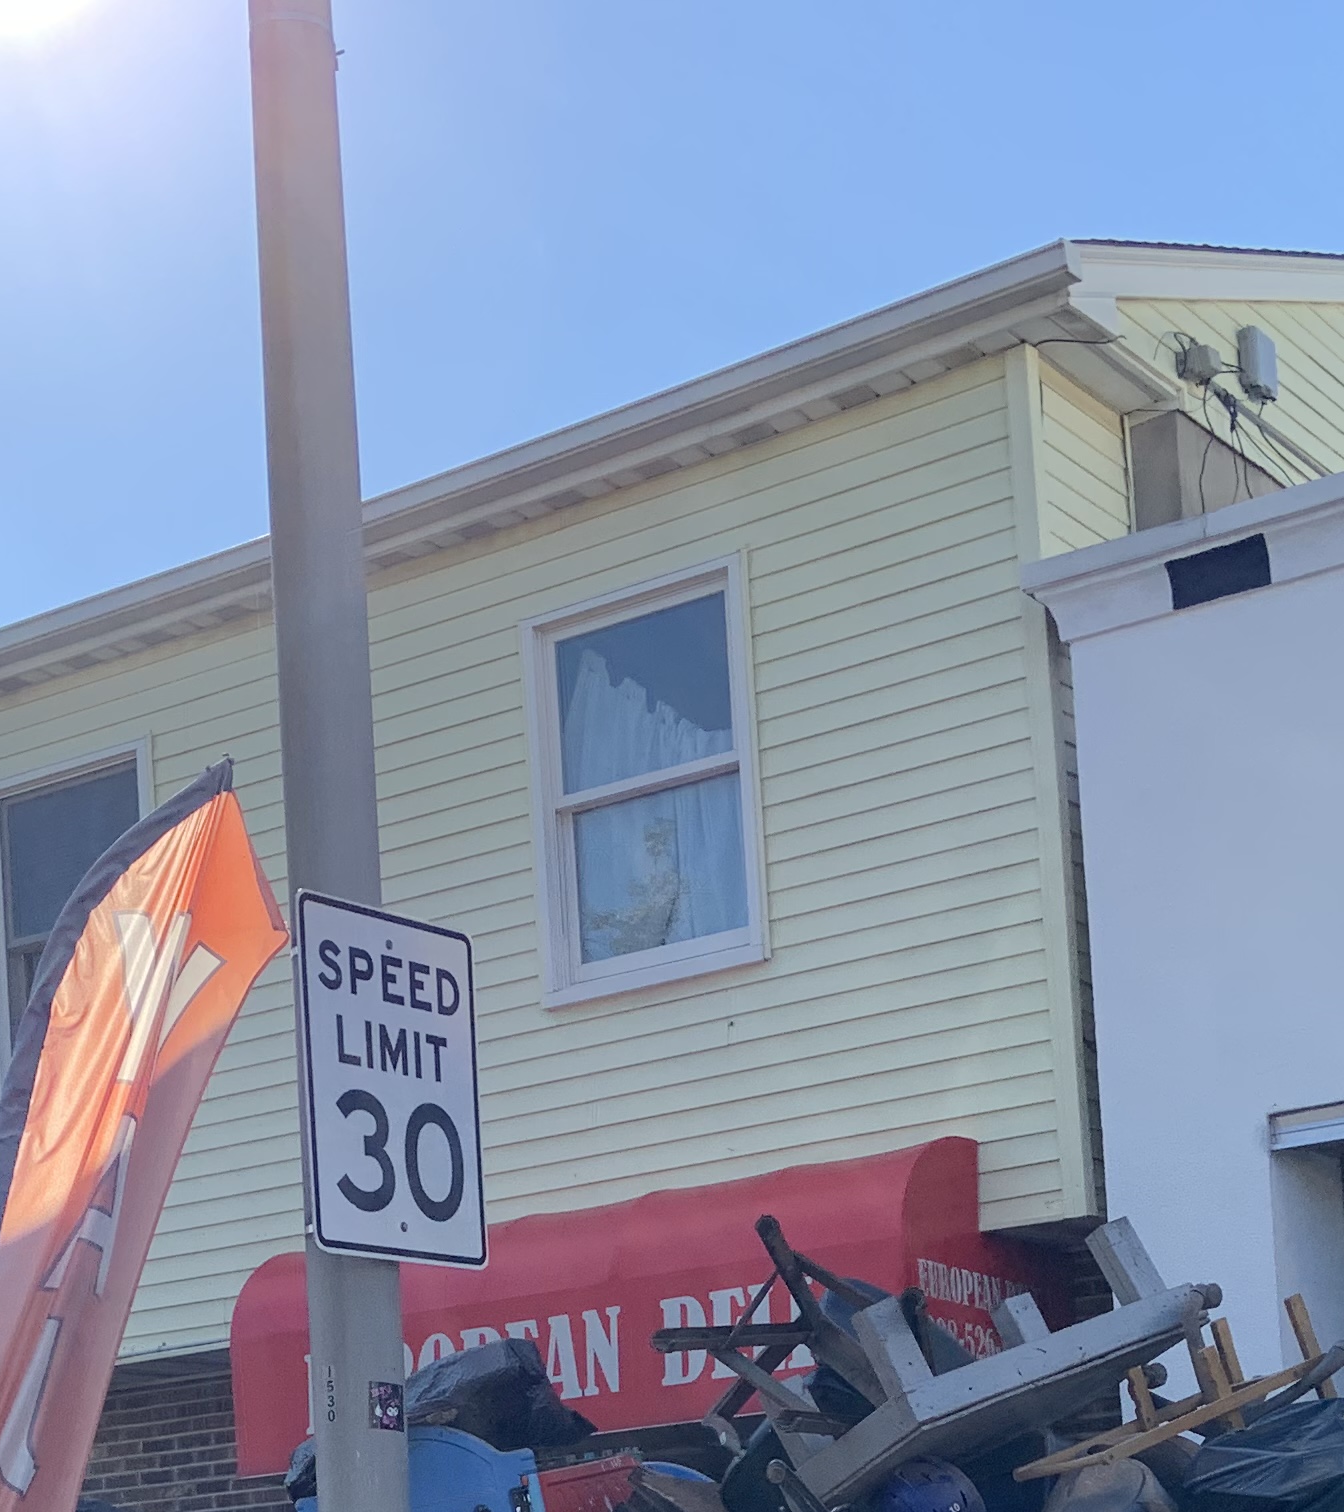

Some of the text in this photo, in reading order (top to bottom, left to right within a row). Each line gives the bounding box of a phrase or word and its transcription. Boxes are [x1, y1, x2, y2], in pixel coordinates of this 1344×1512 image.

[318, 938, 460, 1017] SPEED
[336, 1013, 447, 1083] LIMIT
[336, 1088, 464, 1223] 30
